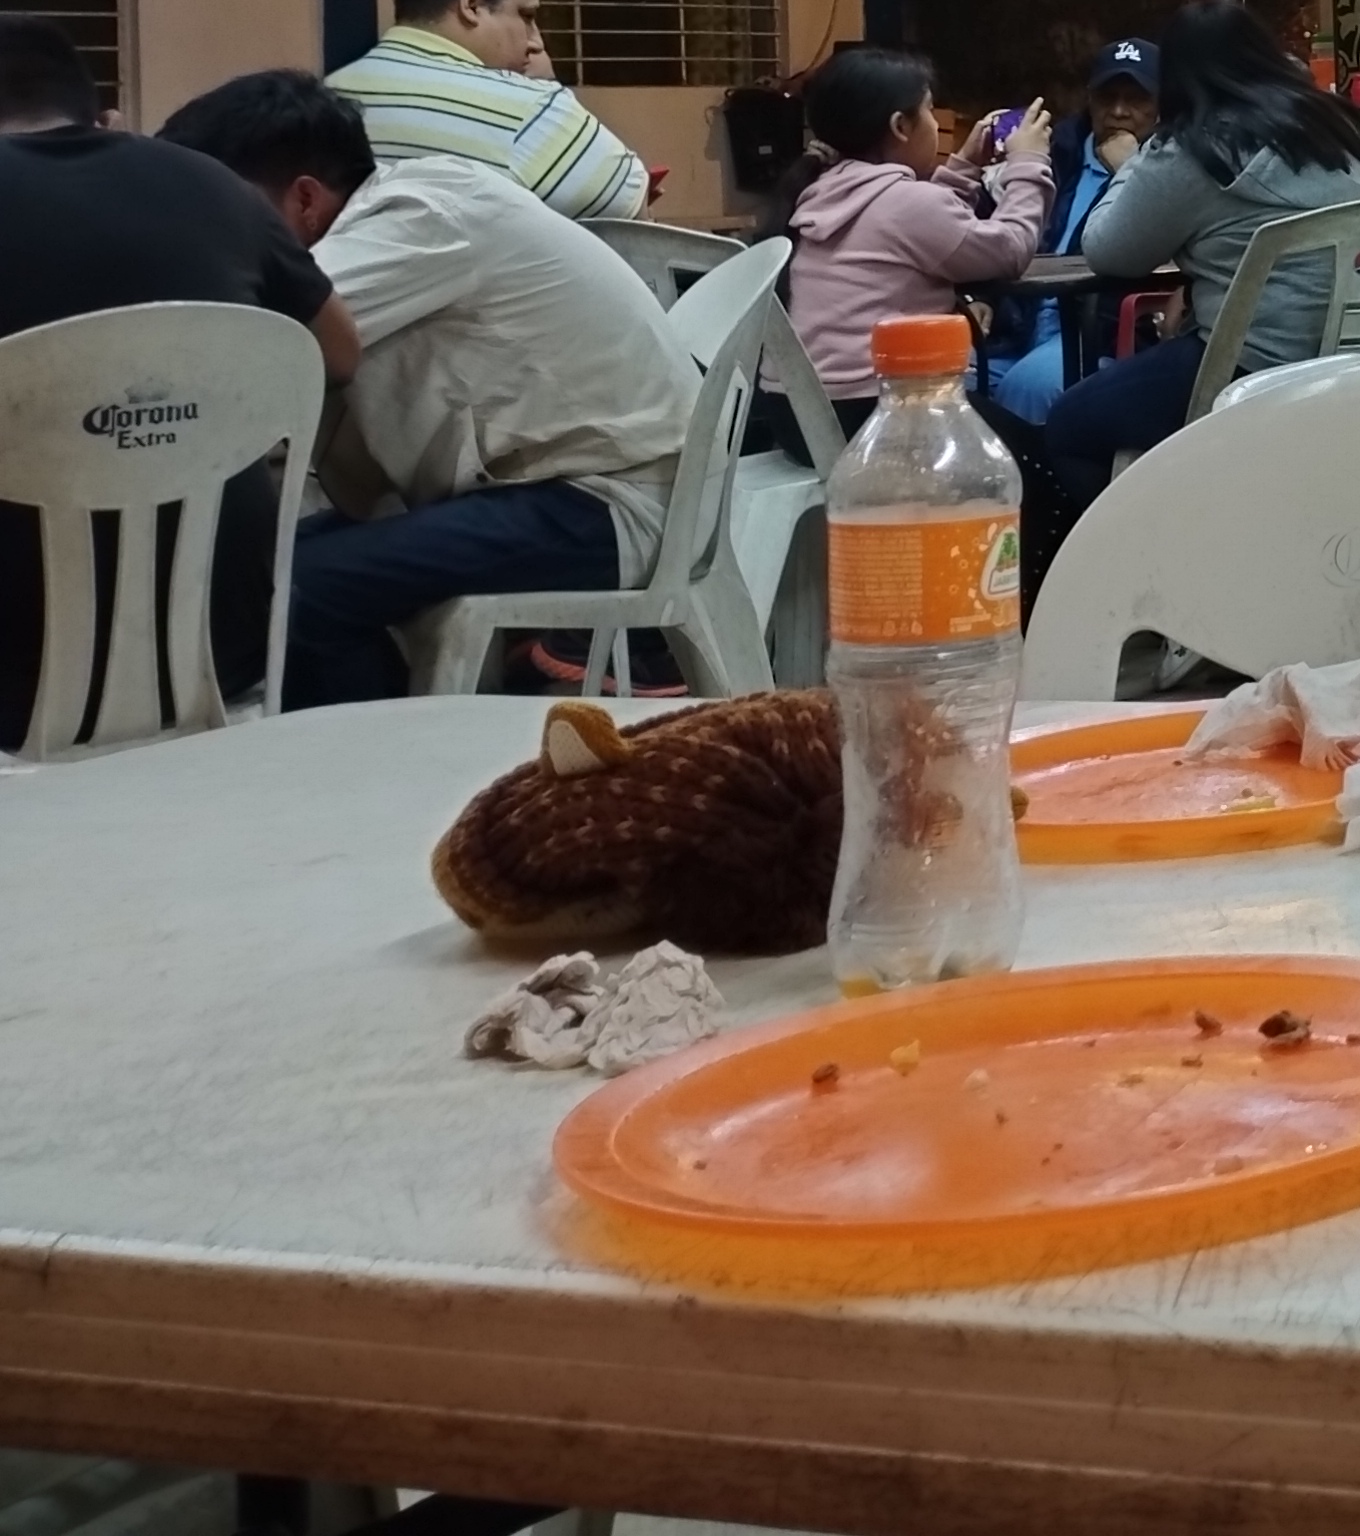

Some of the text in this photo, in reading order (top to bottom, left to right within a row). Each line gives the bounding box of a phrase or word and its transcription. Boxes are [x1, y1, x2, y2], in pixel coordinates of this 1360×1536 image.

[1114, 42, 1141, 61] LA
[82, 403, 199, 437] Corona
[117, 430, 176, 449] Extra
